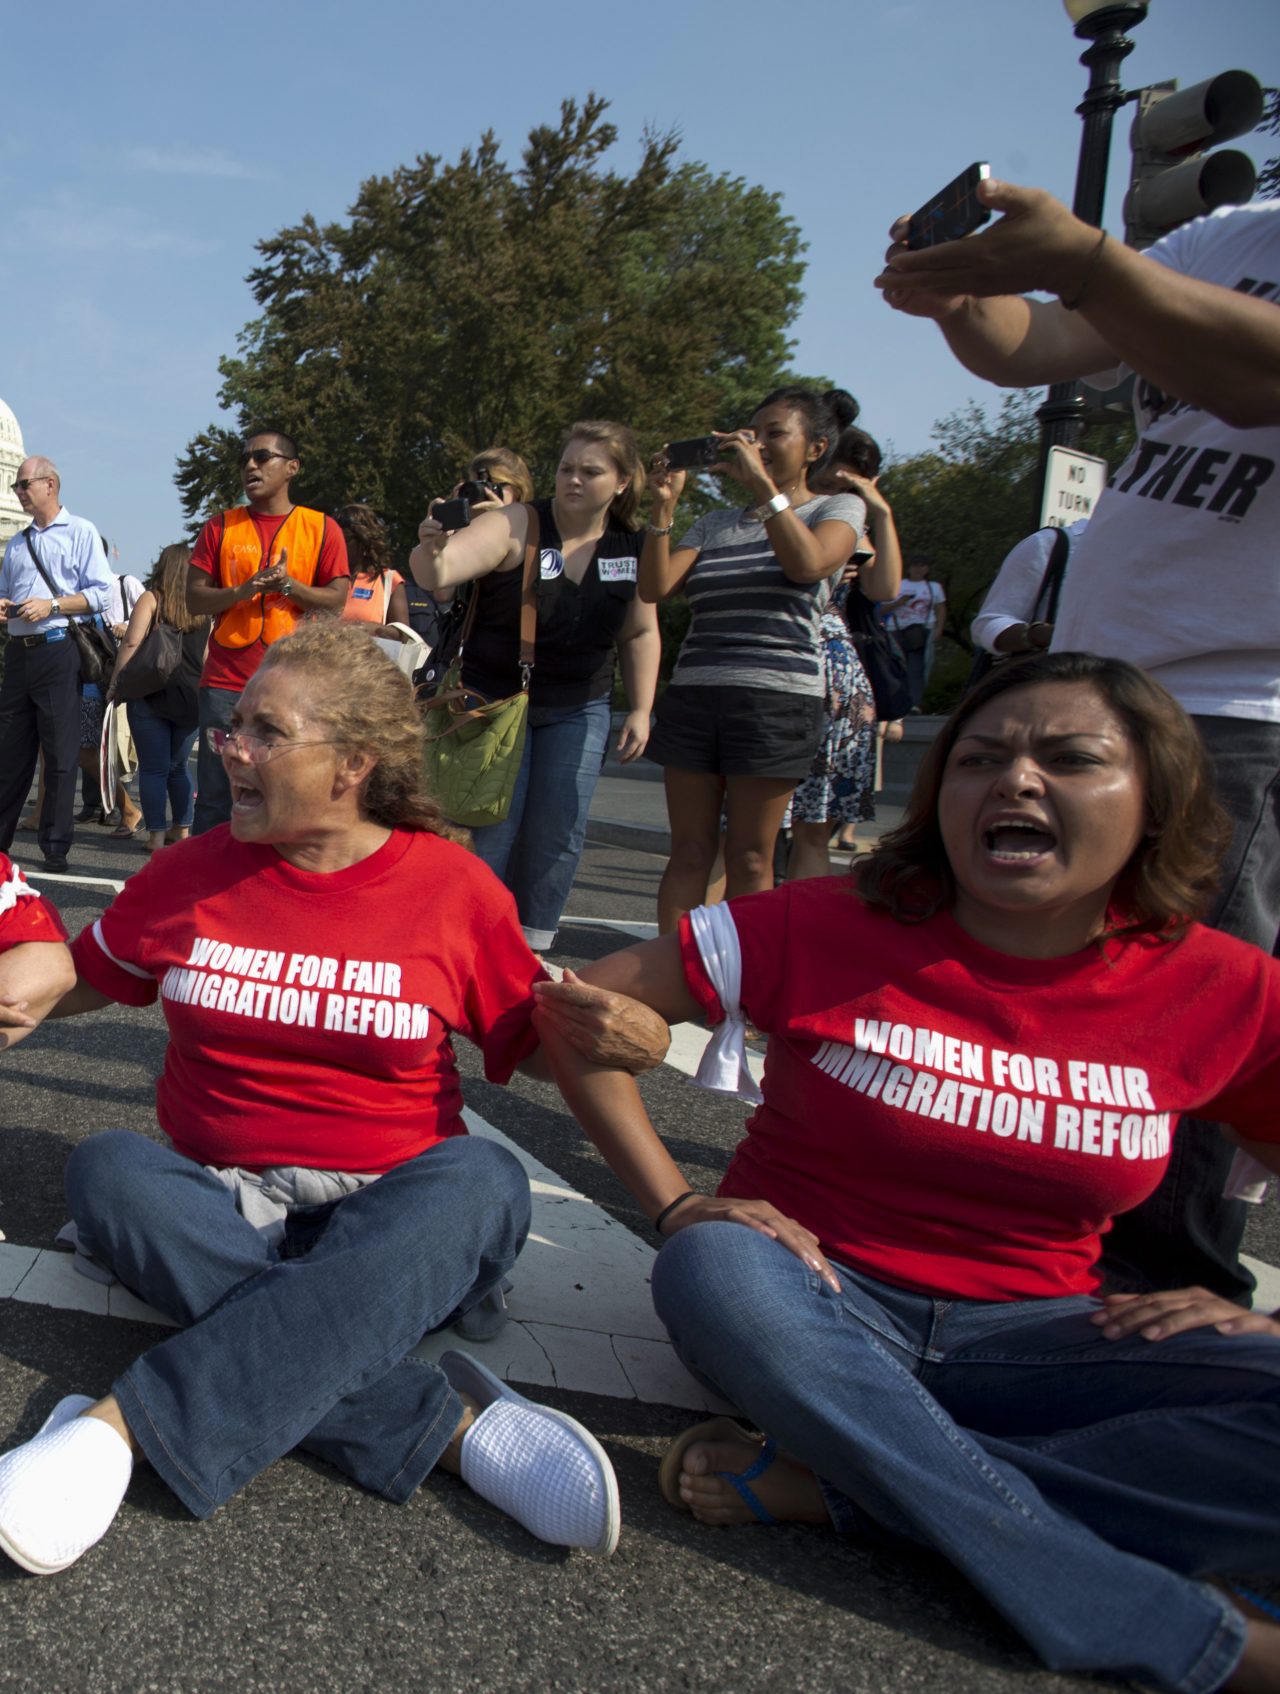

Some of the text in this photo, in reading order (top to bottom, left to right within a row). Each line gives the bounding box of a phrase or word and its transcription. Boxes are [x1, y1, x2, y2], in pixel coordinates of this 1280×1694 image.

[1067, 464, 1086, 484] NO
[1107, 438, 1276, 517] THER
[1058, 490, 1092, 514] TURN
[232, 544, 258, 554] CASA
[601, 560, 635, 569] TRUST
[186, 937, 402, 998] WOMEN FOR FAIR
[323, 993, 430, 1040] REFORM
[854, 1018, 1156, 1111] WOMEN FOR FAIR
[809, 1040, 1171, 1161] IMMIGRATION REFORM
